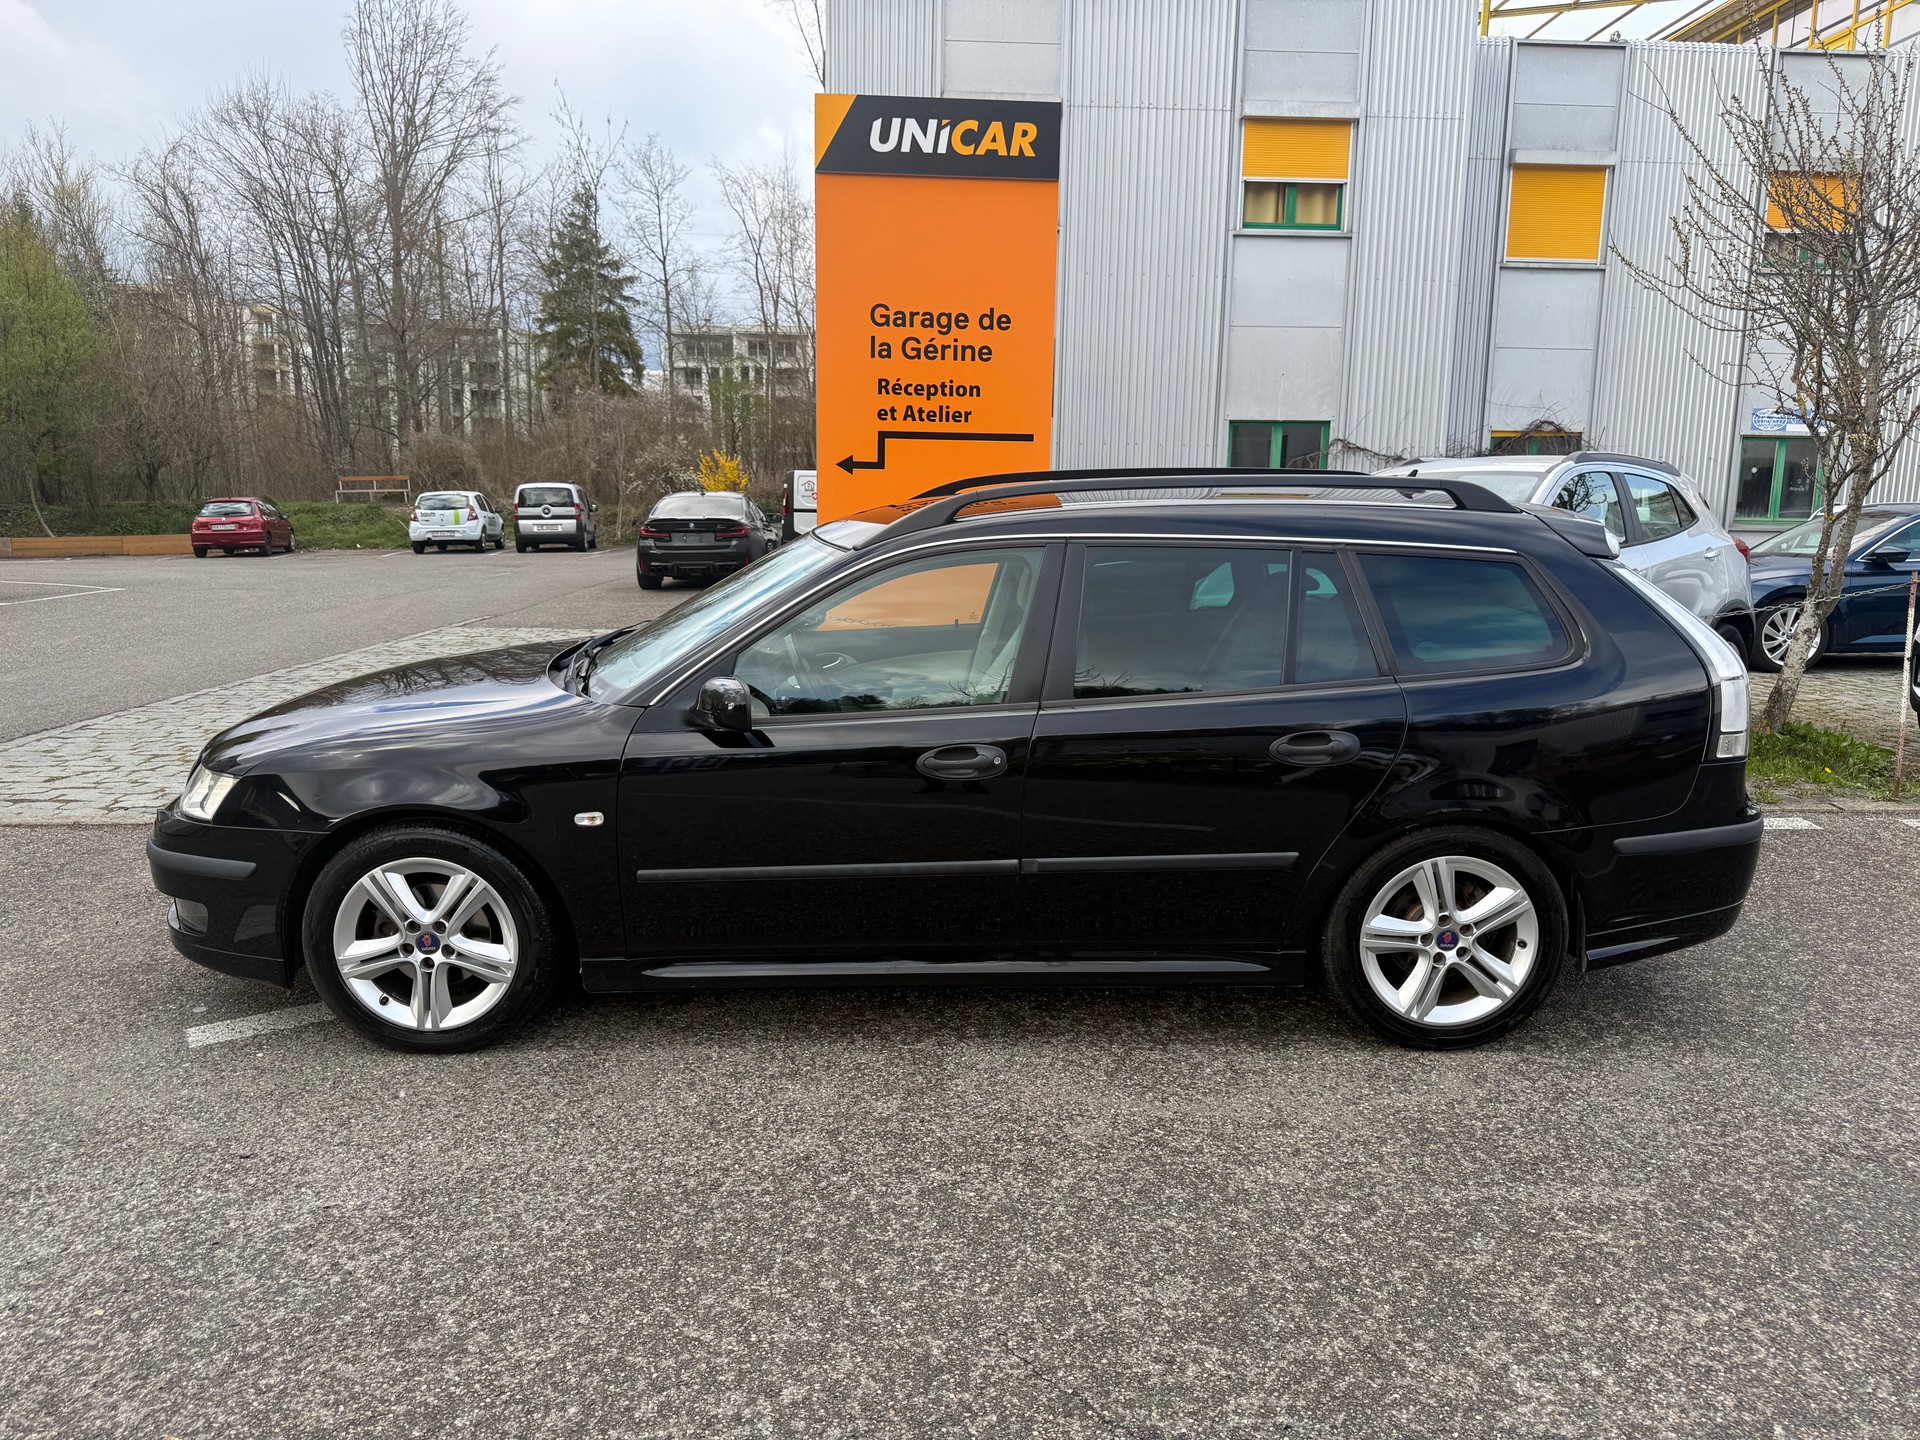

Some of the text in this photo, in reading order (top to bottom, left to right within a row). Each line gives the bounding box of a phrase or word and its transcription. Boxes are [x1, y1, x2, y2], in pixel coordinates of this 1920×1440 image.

[870, 303, 1012, 335] Garage de
[870, 335, 993, 362] la Gérine
[877, 378, 981, 401] Réception
[877, 405, 972, 423] et Atelier
